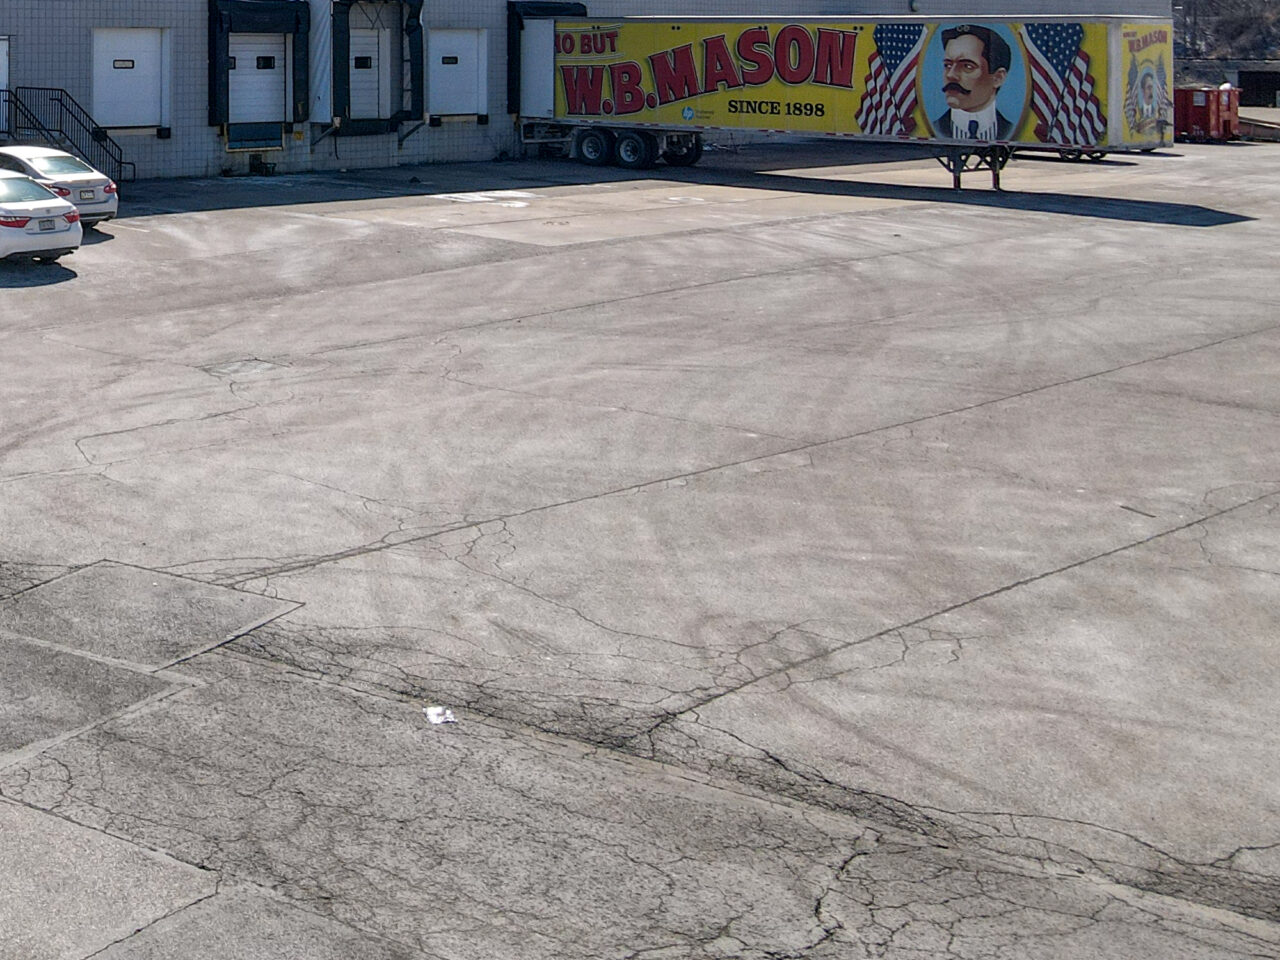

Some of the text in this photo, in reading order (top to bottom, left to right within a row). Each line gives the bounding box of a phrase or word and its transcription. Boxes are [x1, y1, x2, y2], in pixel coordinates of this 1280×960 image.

[580, 30, 618, 55] BUT
[728, 99, 780, 115] SINCE
[785, 102, 825, 117] 1898
